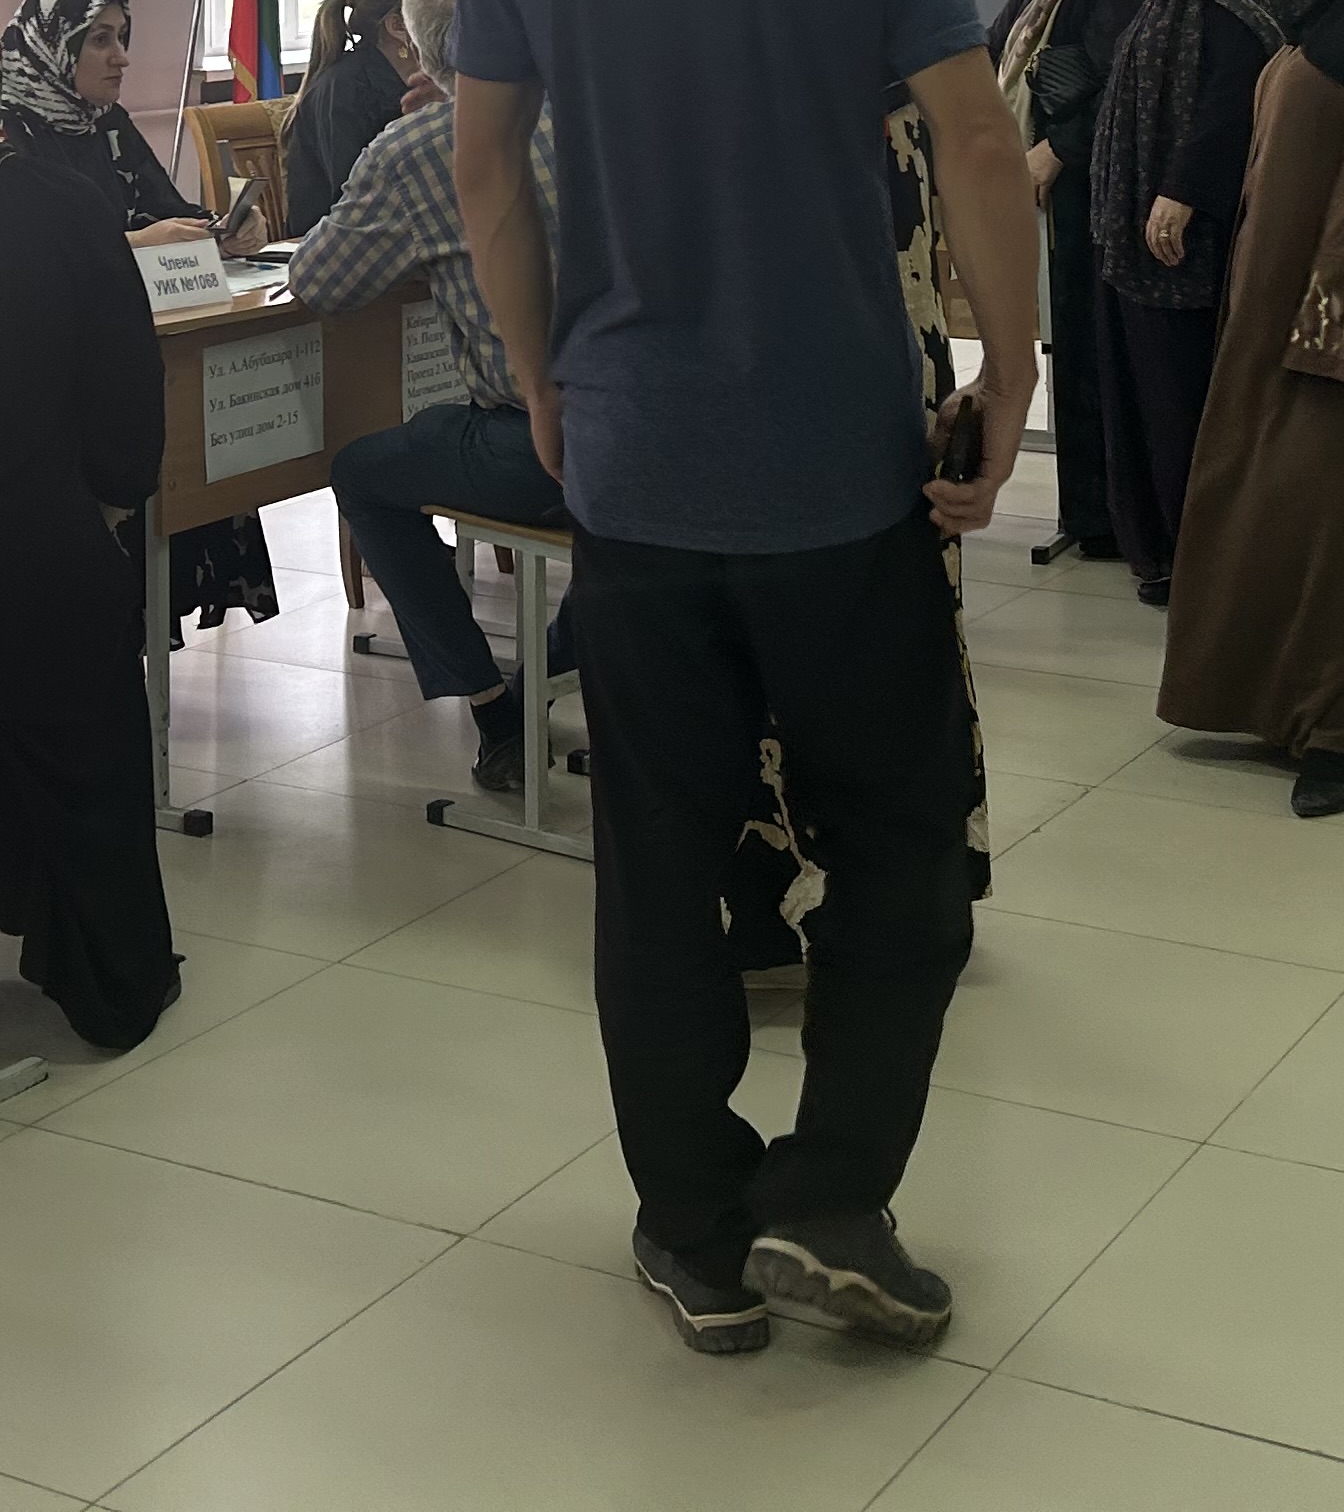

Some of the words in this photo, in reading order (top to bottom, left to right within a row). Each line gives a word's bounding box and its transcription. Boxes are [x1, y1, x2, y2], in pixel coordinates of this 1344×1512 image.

[158, 255, 200, 271] Члены
[153, 278, 180, 296] УИК
[180, 273, 219, 293] №1068
[209, 399, 226, 413] Ул.
[229, 386, 280, 408] Бакинская
[282, 381, 301, 395] дом
[210, 432, 228, 447] Без
[256, 419, 275, 434] дом
[276, 409, 299, 428] 2-15
